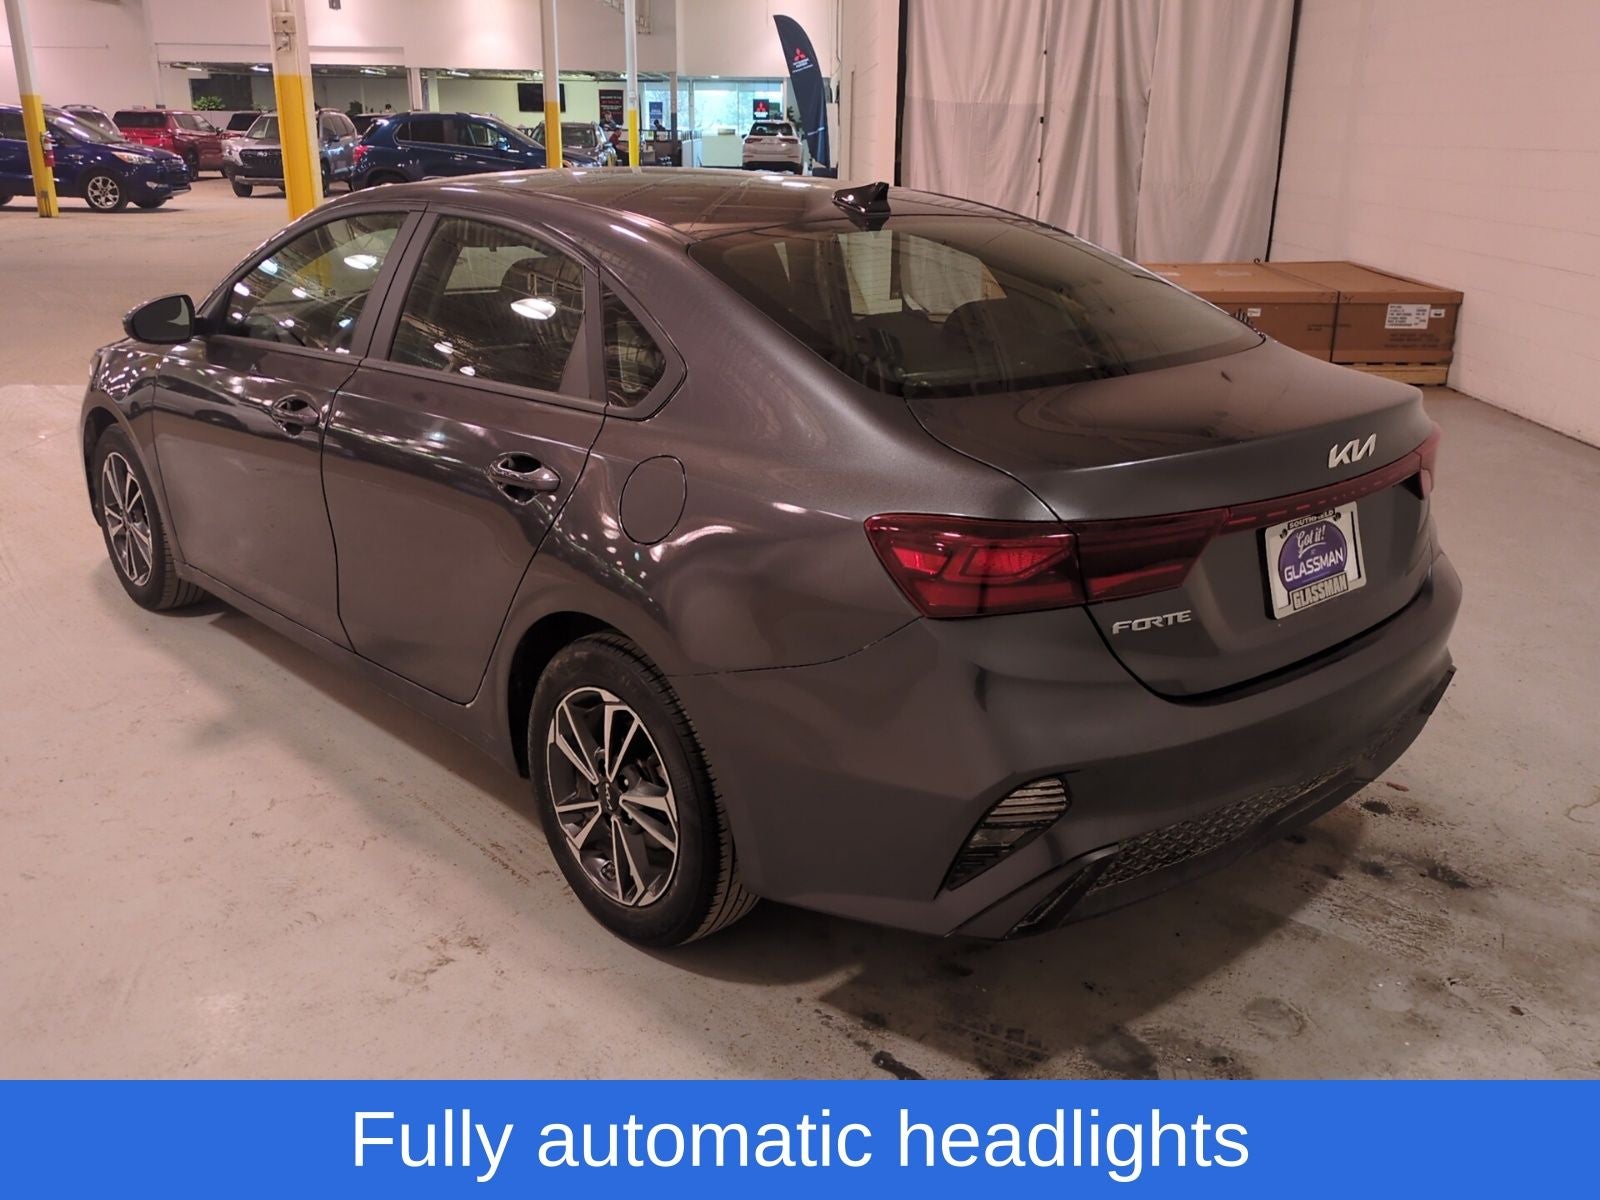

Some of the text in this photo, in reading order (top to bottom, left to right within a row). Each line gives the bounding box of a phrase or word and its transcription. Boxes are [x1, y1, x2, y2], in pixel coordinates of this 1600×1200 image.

[1328, 433, 1377, 469] KIA
[1296, 530, 1313, 552] Got
[1284, 547, 1344, 583] GLASSMAN
[1293, 575, 1347, 610] GLASSMAN
[1112, 609, 1192, 635] FORTE
